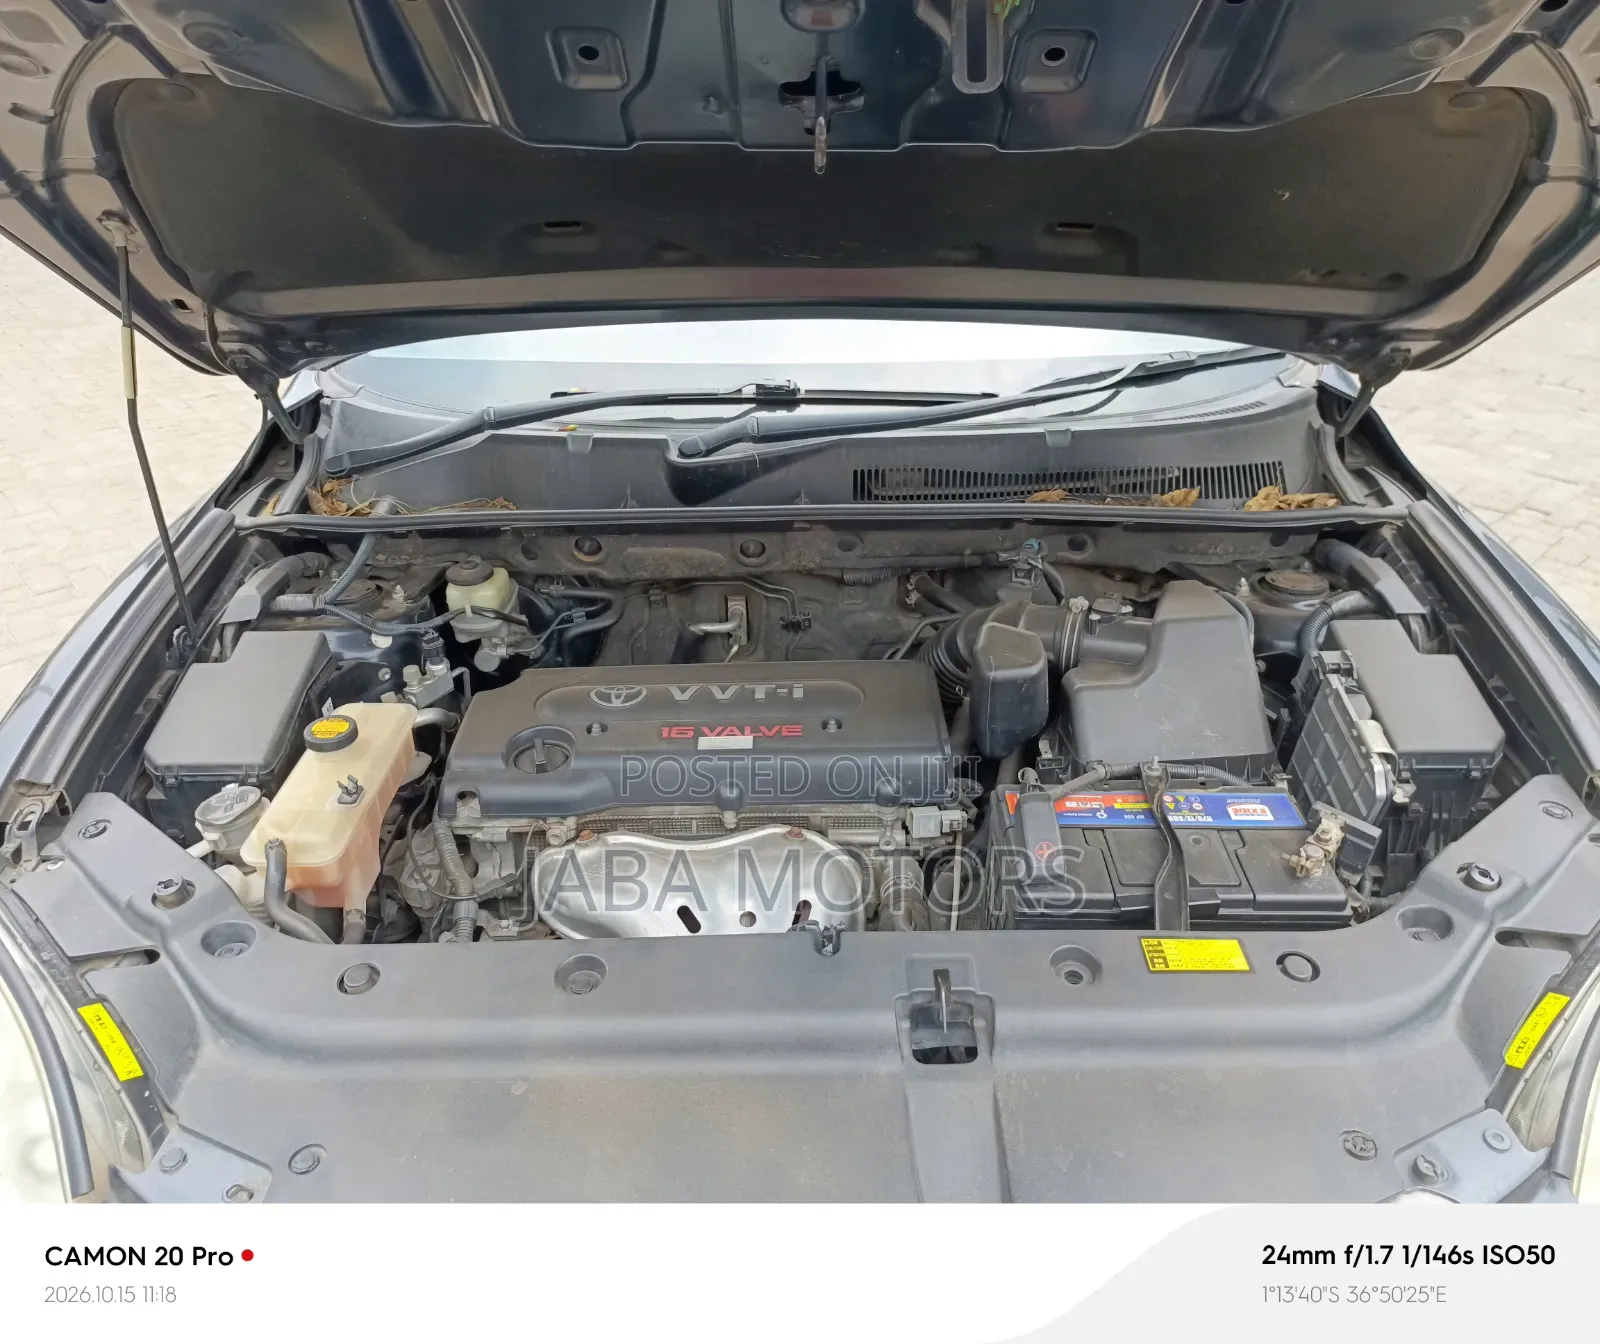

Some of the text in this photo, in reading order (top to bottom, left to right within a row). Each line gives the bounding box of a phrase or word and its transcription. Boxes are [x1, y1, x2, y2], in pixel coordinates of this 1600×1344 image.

[667, 684, 804, 701] VVT-i
[660, 725, 803, 739] 16 VALVE
